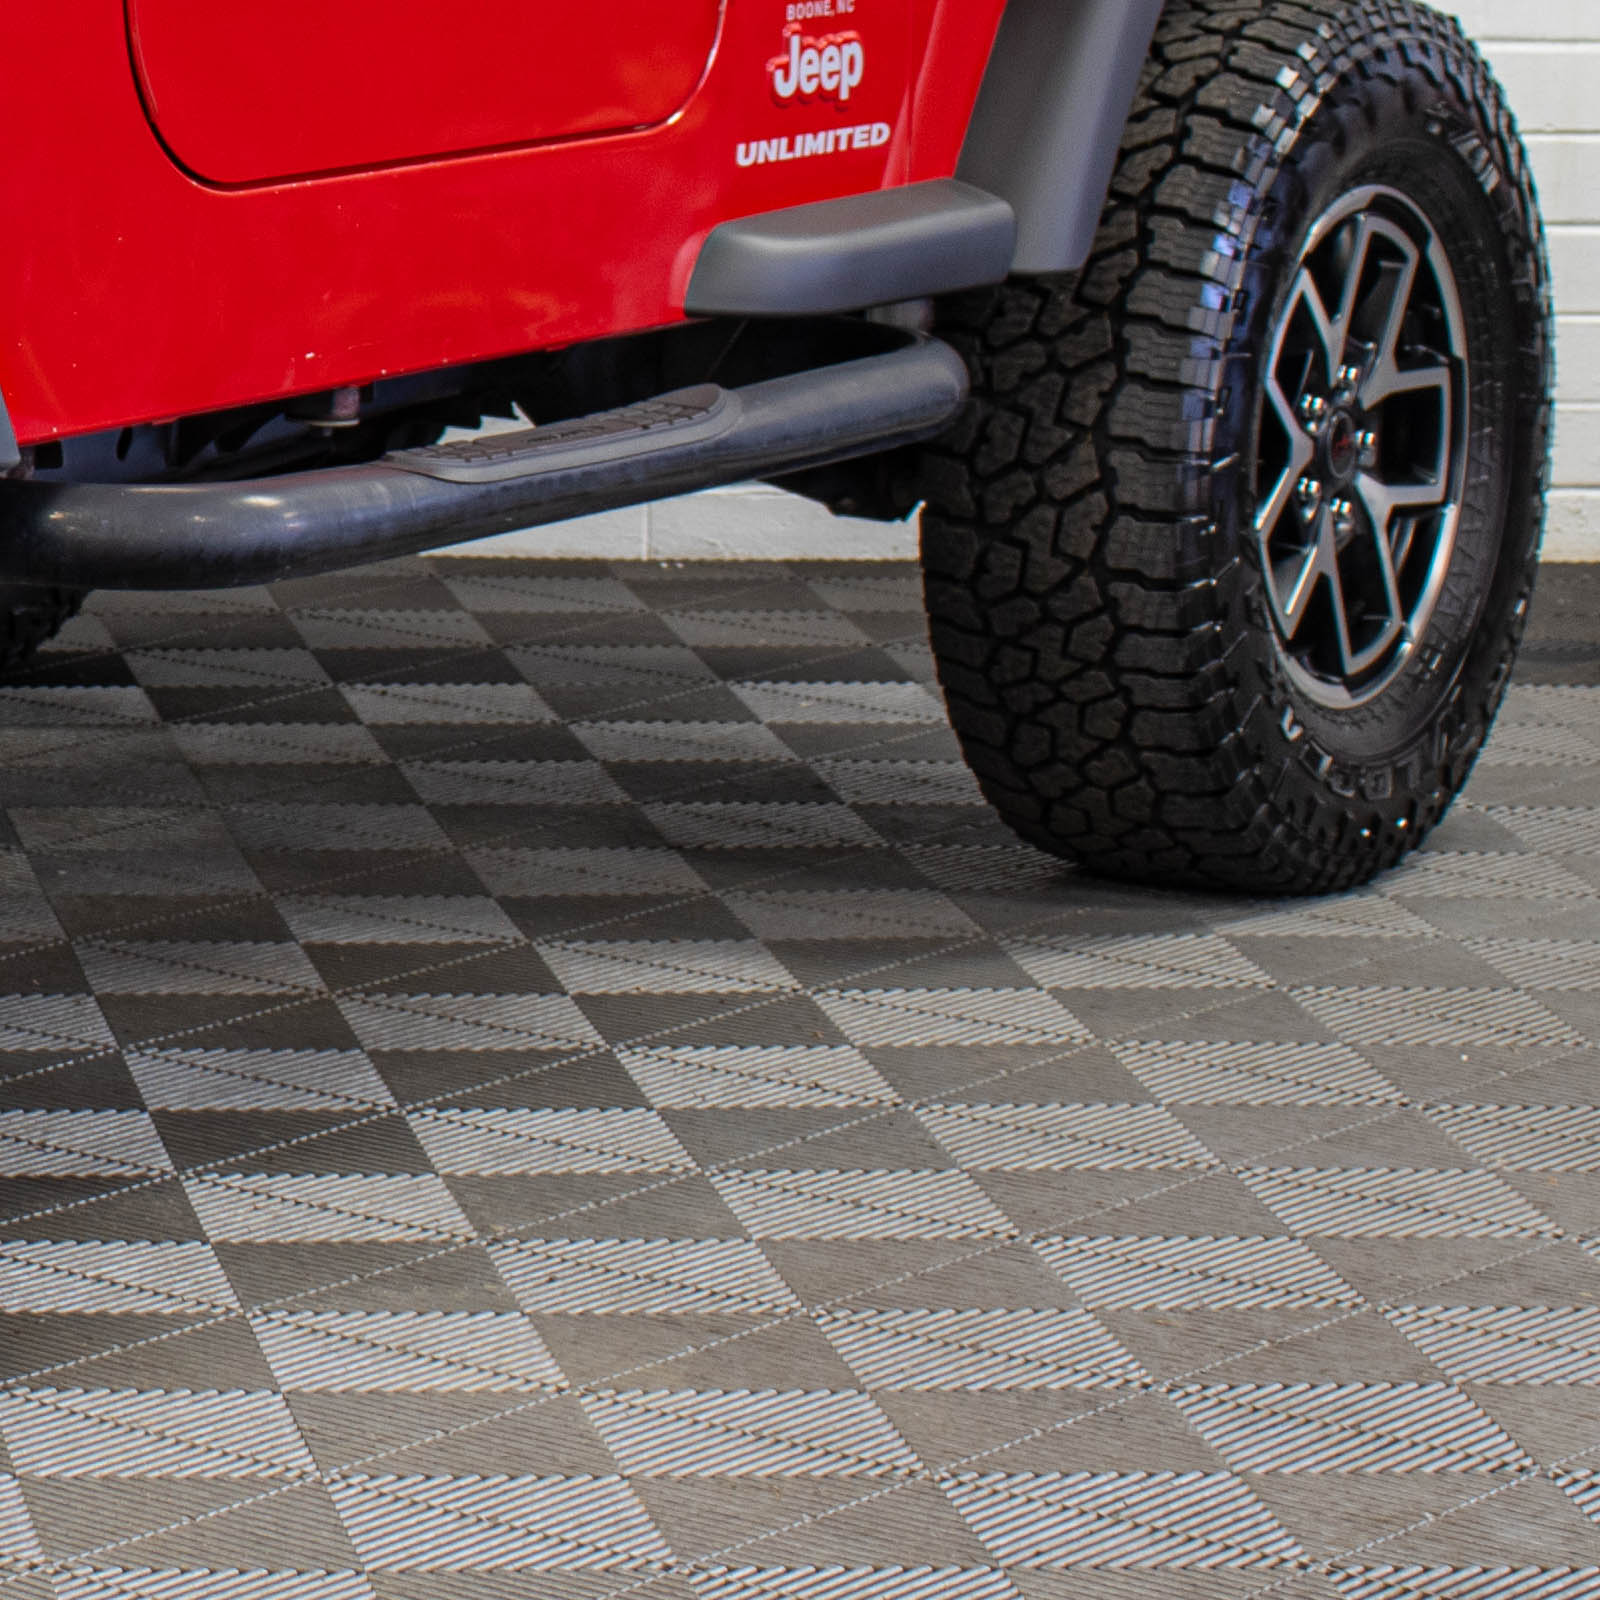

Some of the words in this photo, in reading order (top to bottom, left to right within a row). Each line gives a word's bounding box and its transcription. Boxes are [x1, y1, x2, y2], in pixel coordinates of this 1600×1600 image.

[786, 0, 835, 21] BOONE,
[773, 34, 864, 101] Jeep
[735, 122, 891, 167] UNLIMITED
